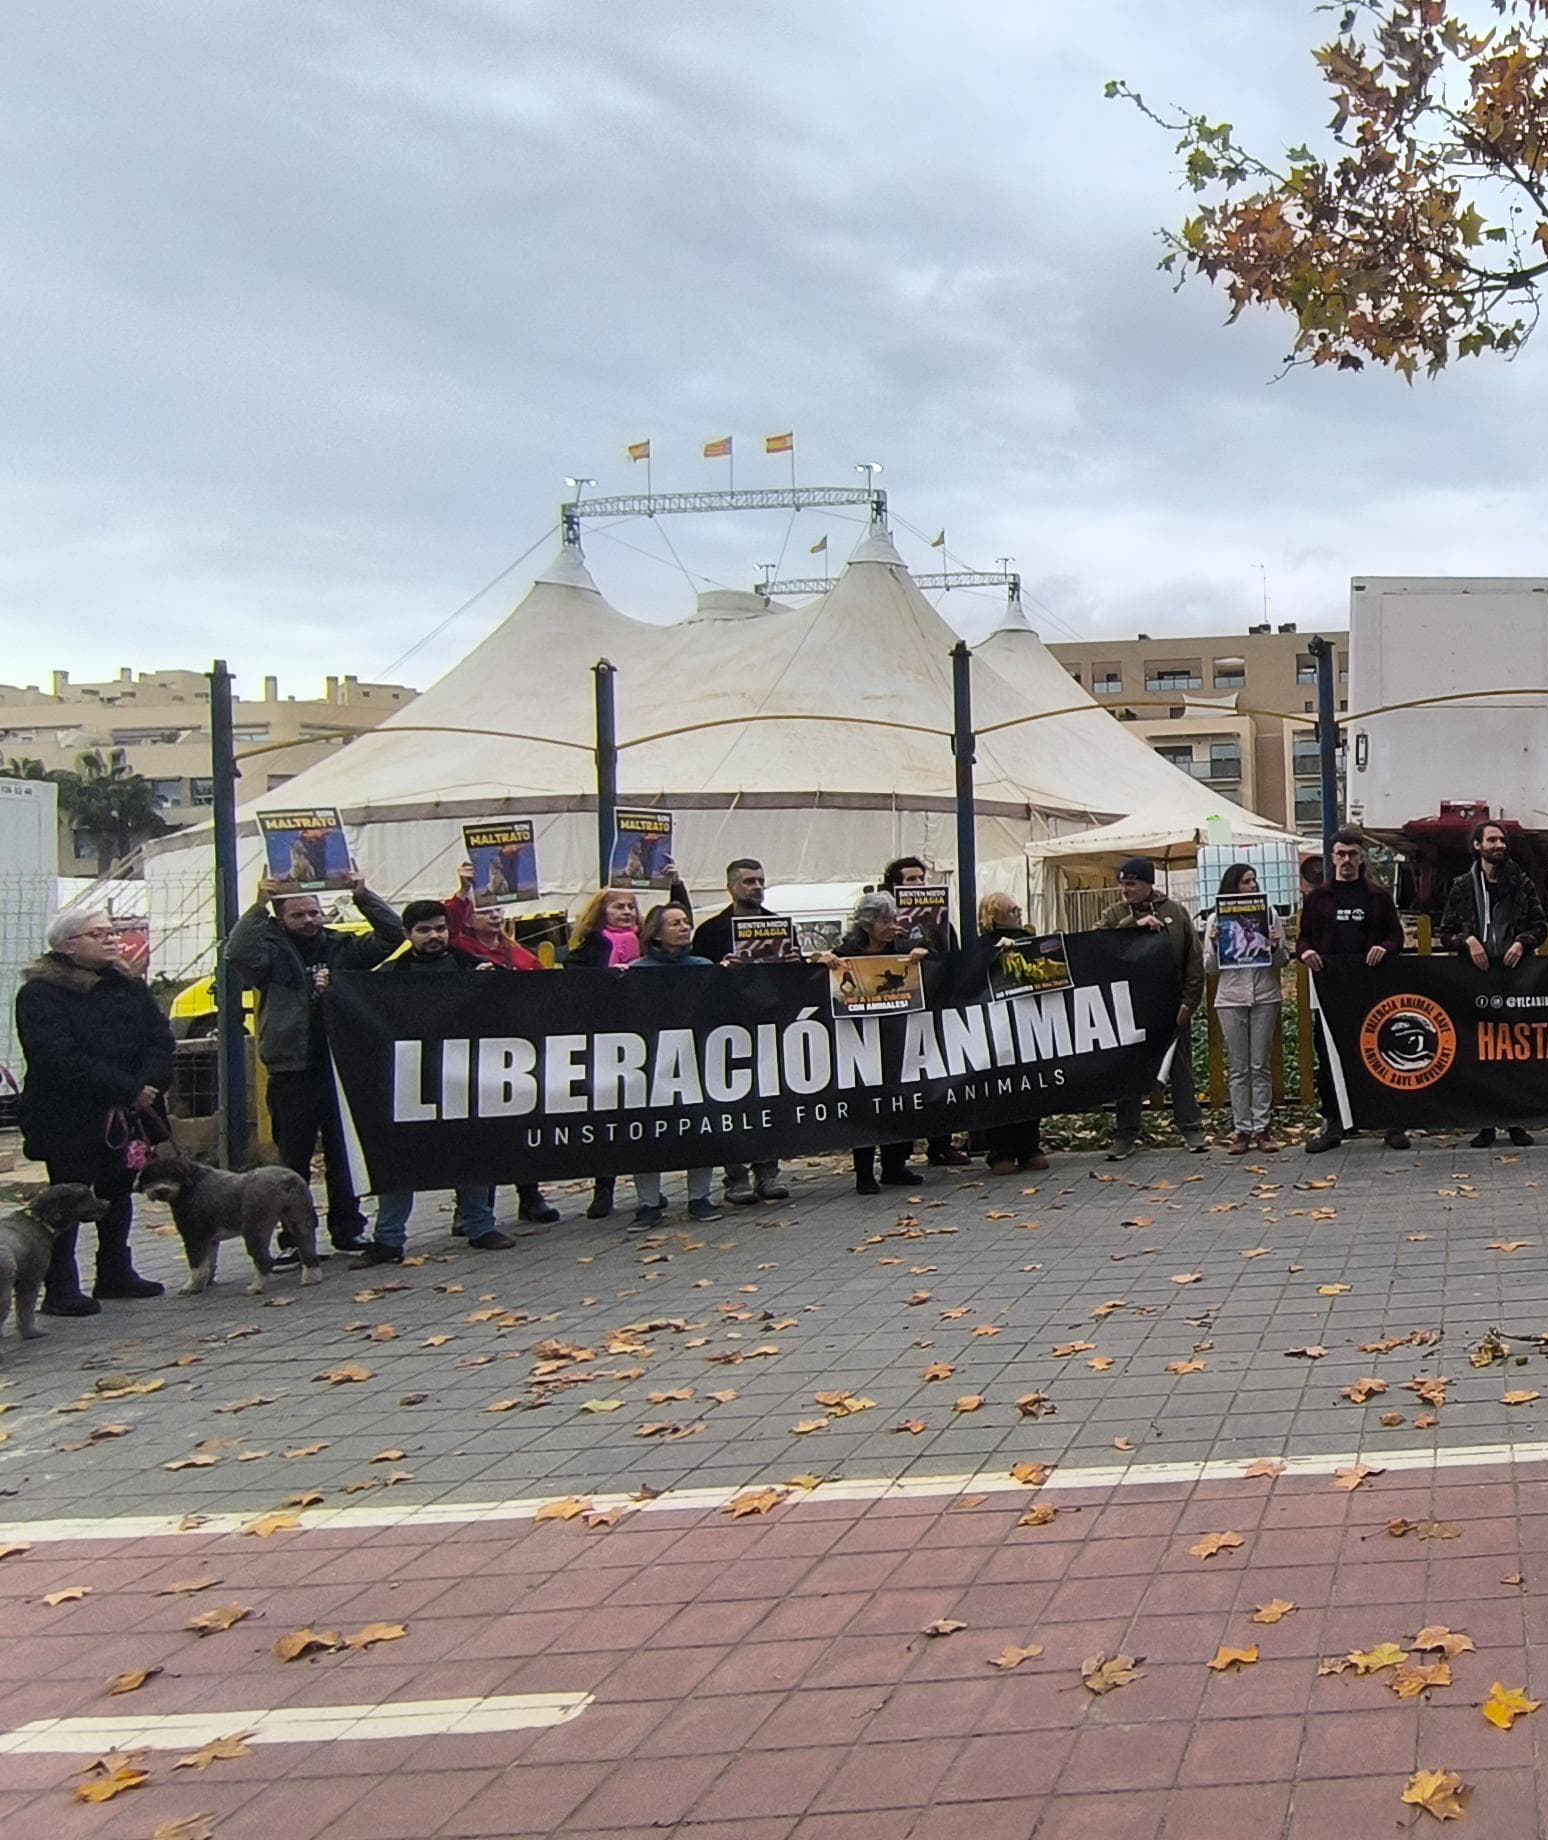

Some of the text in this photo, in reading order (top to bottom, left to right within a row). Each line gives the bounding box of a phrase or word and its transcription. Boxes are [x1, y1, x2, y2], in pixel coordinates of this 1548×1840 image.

[265, 817, 337, 830] MALTRATO
[620, 820, 670, 832] MALTRATO
[469, 831, 531, 846] MALTRATO
[899, 897, 945, 906] NO MAGIA
[738, 928, 788, 938] NO MAGIA
[848, 1004, 866, 1012] CON
[1364, 997, 1453, 1034] VALENCIA ANIMAL SAVE
[394, 979, 1147, 1123] LIBERACIÓN ANIMAL
[1364, 1046, 1452, 1087] ANIMAL SAVE MOVEMENT
[527, 1068, 1066, 1147] UNSTOPPABLE FOR THE ANIMALS
